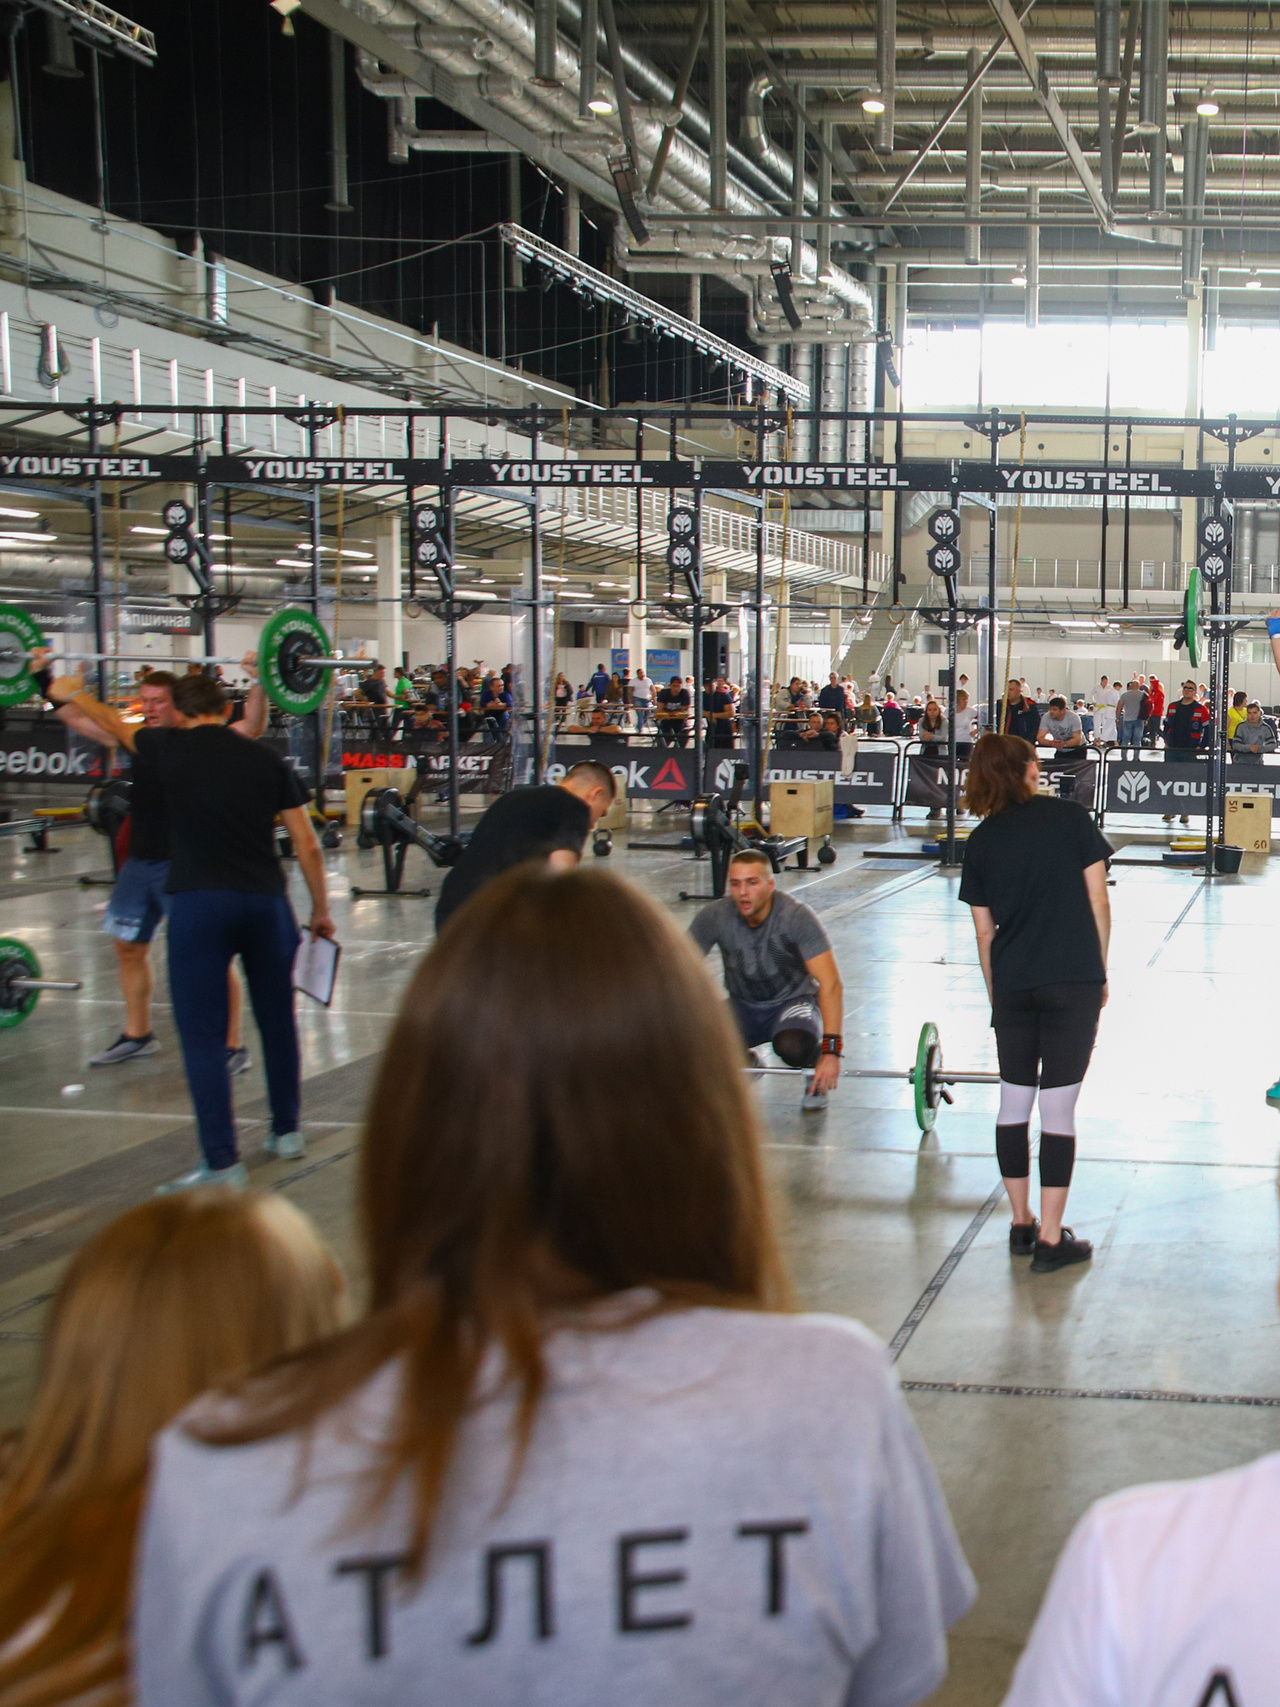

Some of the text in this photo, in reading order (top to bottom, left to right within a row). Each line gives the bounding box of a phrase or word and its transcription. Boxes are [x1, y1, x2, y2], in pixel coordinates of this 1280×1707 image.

[1, 456, 161, 477] YOUSTEEL
[246, 460, 405, 480] YOUSTEEL
[491, 463, 654, 483] YOUSTEEL
[742, 466, 910, 486] YOUSTEEL
[1001, 470, 1172, 492] YOUSTEEL
[342, 752, 404, 769] MASS
[1228, 800, 1238, 813] 50
[1253, 839, 1267, 849] 60
[240, 1517, 810, 1672] АТЛЕТ
